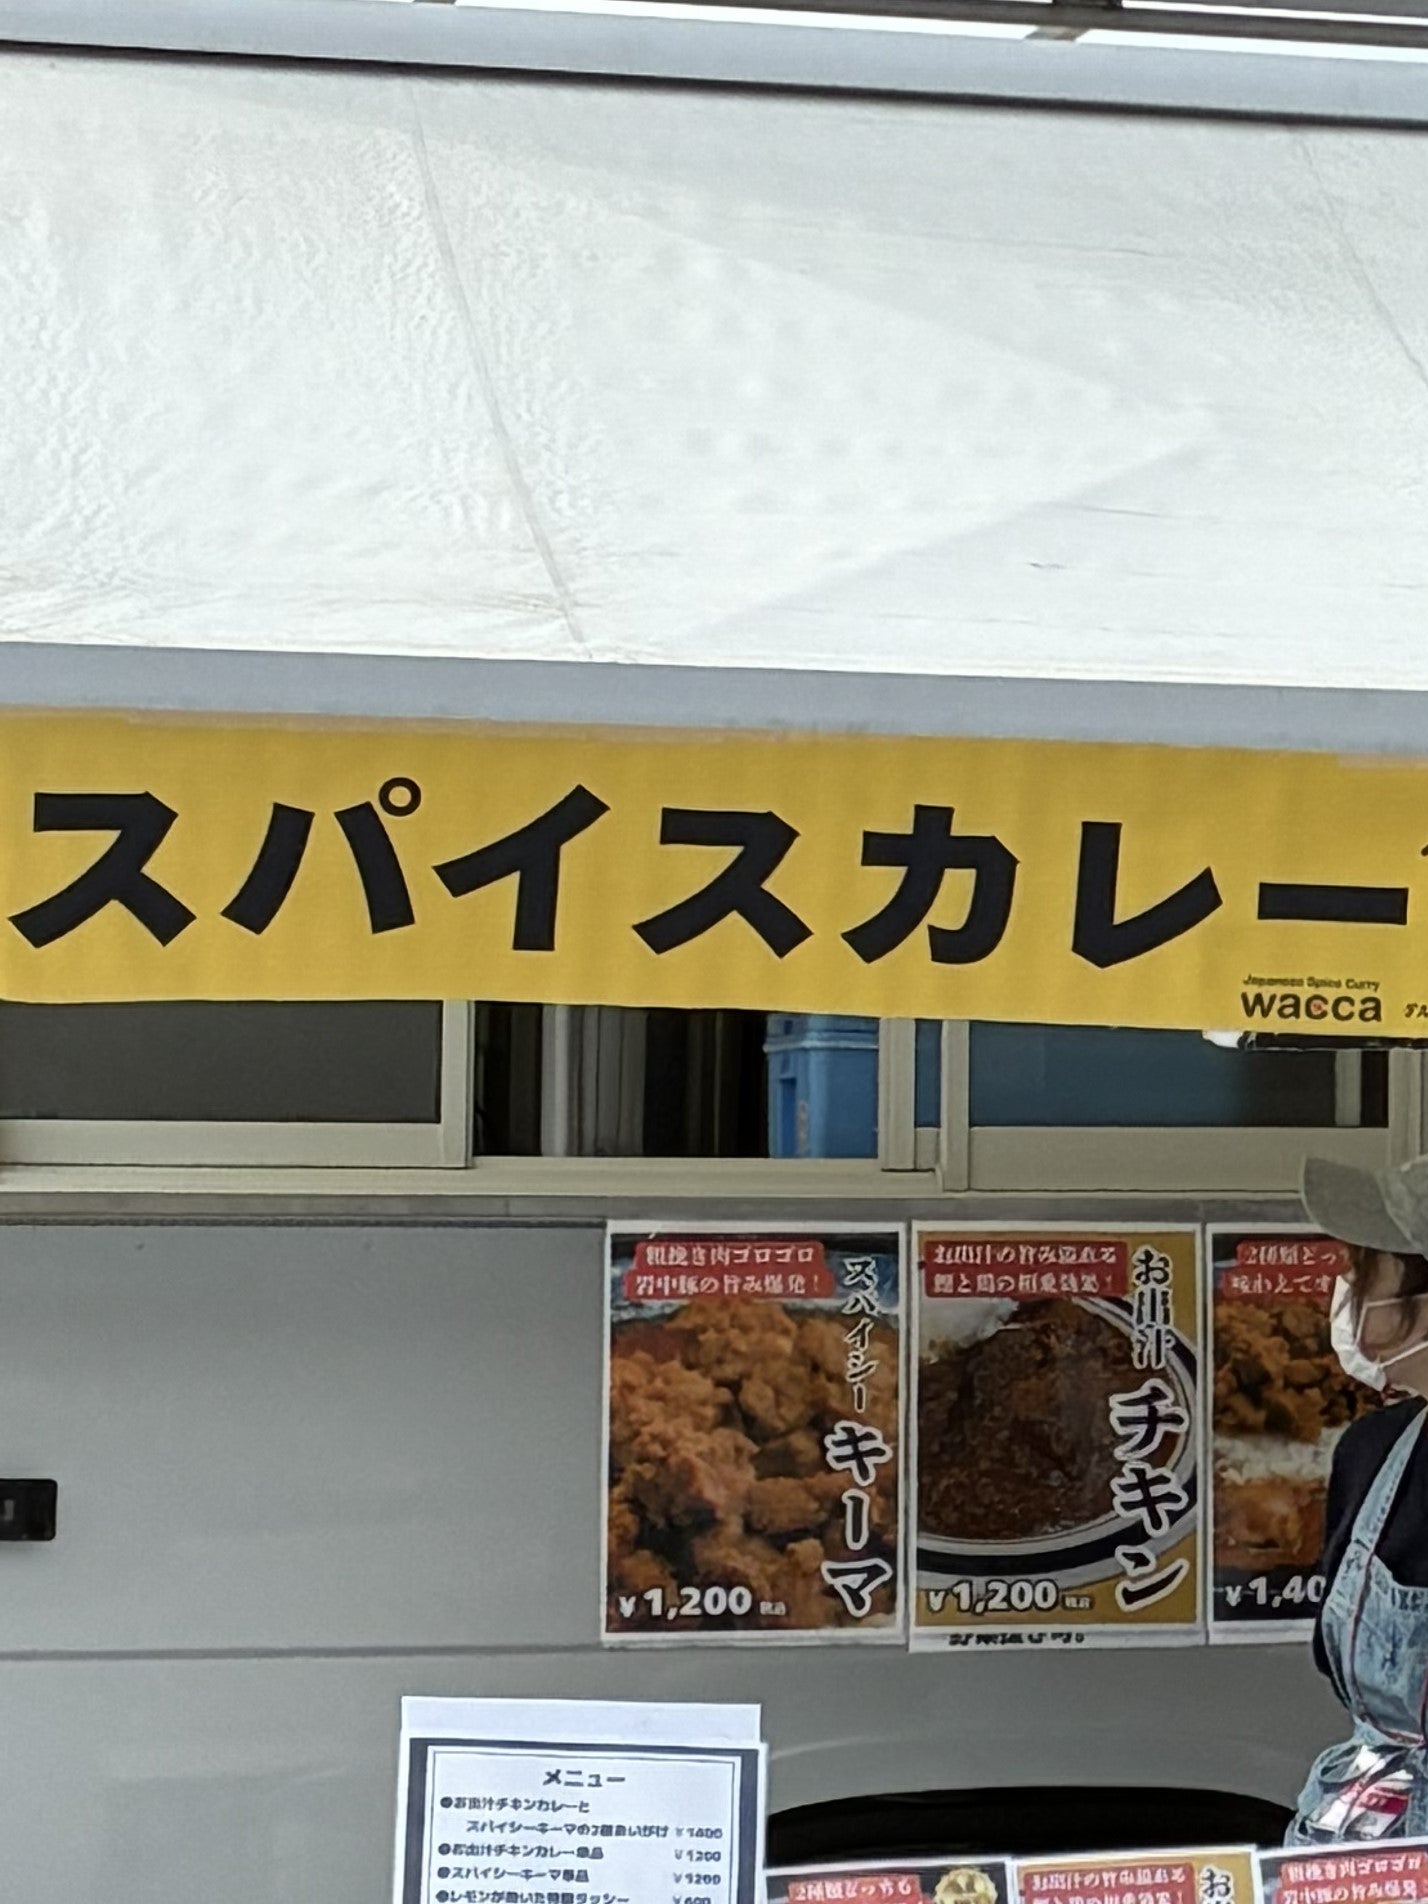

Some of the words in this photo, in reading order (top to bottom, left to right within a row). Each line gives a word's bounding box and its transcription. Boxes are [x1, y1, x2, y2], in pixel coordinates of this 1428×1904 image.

[6, 776, 1409, 969] スパイスカレー
[1240, 990, 1382, 1023] wacca
[1224, 1575, 1325, 1608] ¥1,40
[542, 1768, 626, 1788] メニュー
